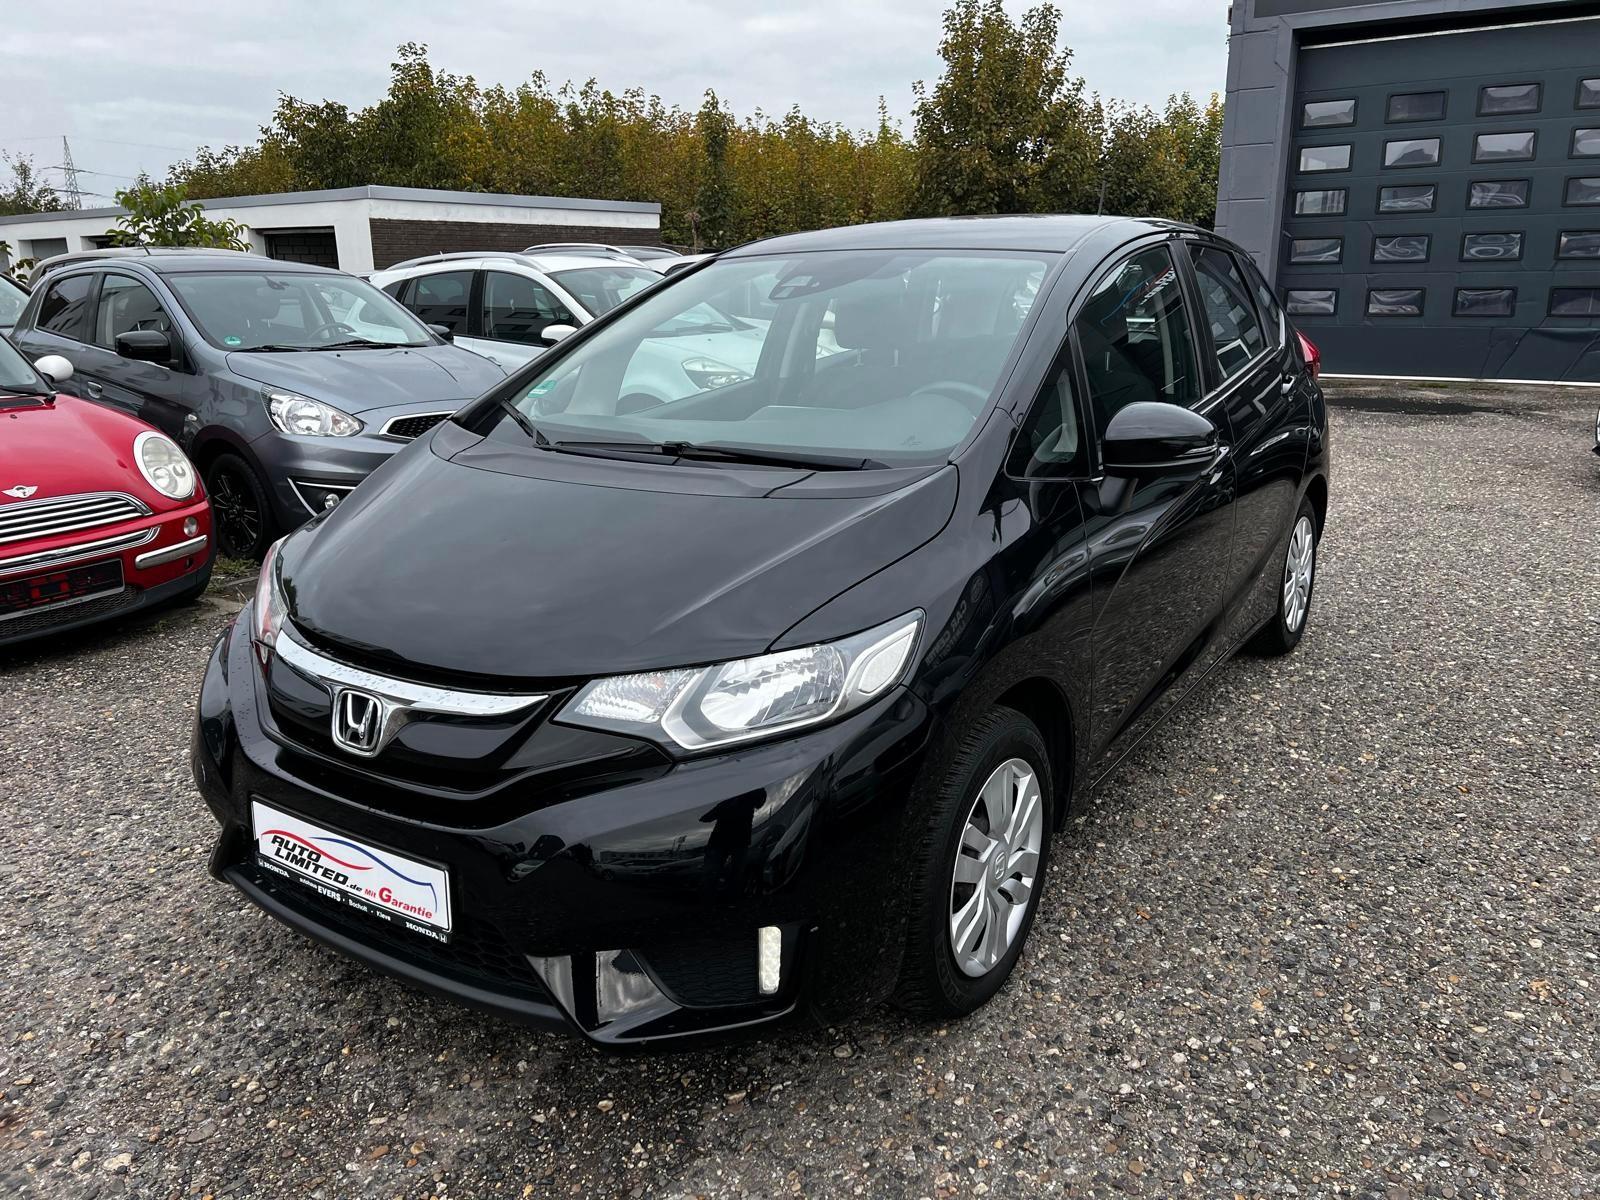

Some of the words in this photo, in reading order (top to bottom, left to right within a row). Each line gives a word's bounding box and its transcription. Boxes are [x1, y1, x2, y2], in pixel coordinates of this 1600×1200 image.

[271, 835, 322, 863] AUTO
[317, 885, 342, 902] EVERS
[364, 888, 377, 898] Mit
[378, 887, 433, 919] Garantie
[405, 921, 439, 940] HONDA
